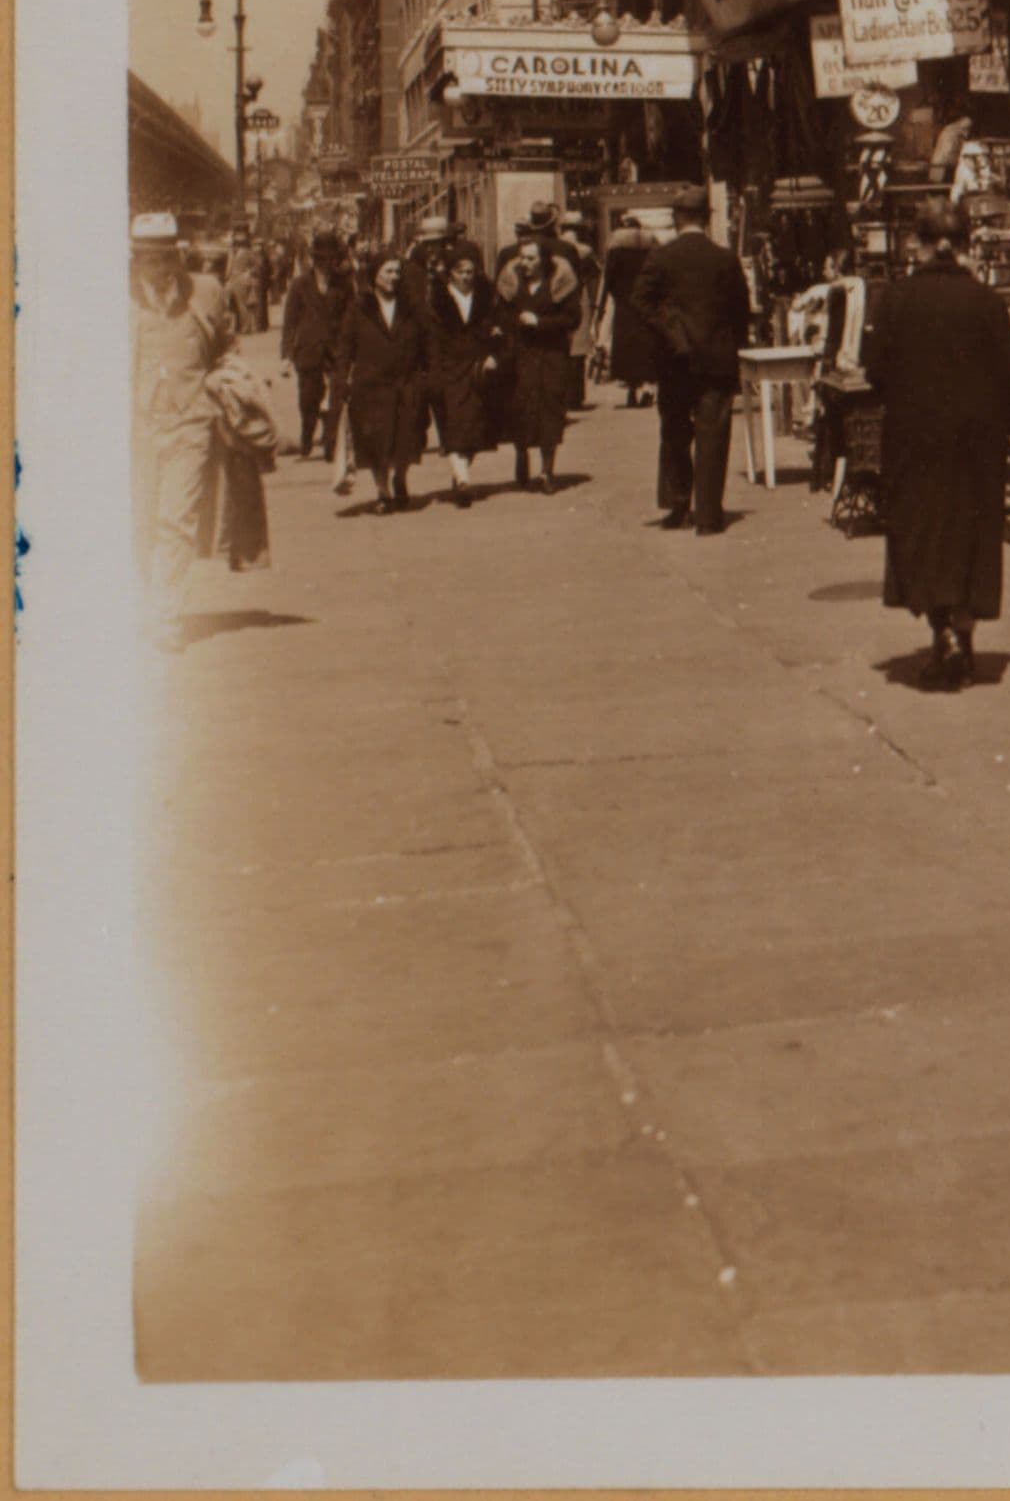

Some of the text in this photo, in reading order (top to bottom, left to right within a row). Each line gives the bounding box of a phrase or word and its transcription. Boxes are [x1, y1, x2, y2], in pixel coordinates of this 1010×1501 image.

[490, 55, 643, 77] CAROLINA
[530, 78, 601, 96] SYMPHONY
[383, 159, 428, 170] POSTAL
[373, 170, 439, 181] TELEGRAPH
